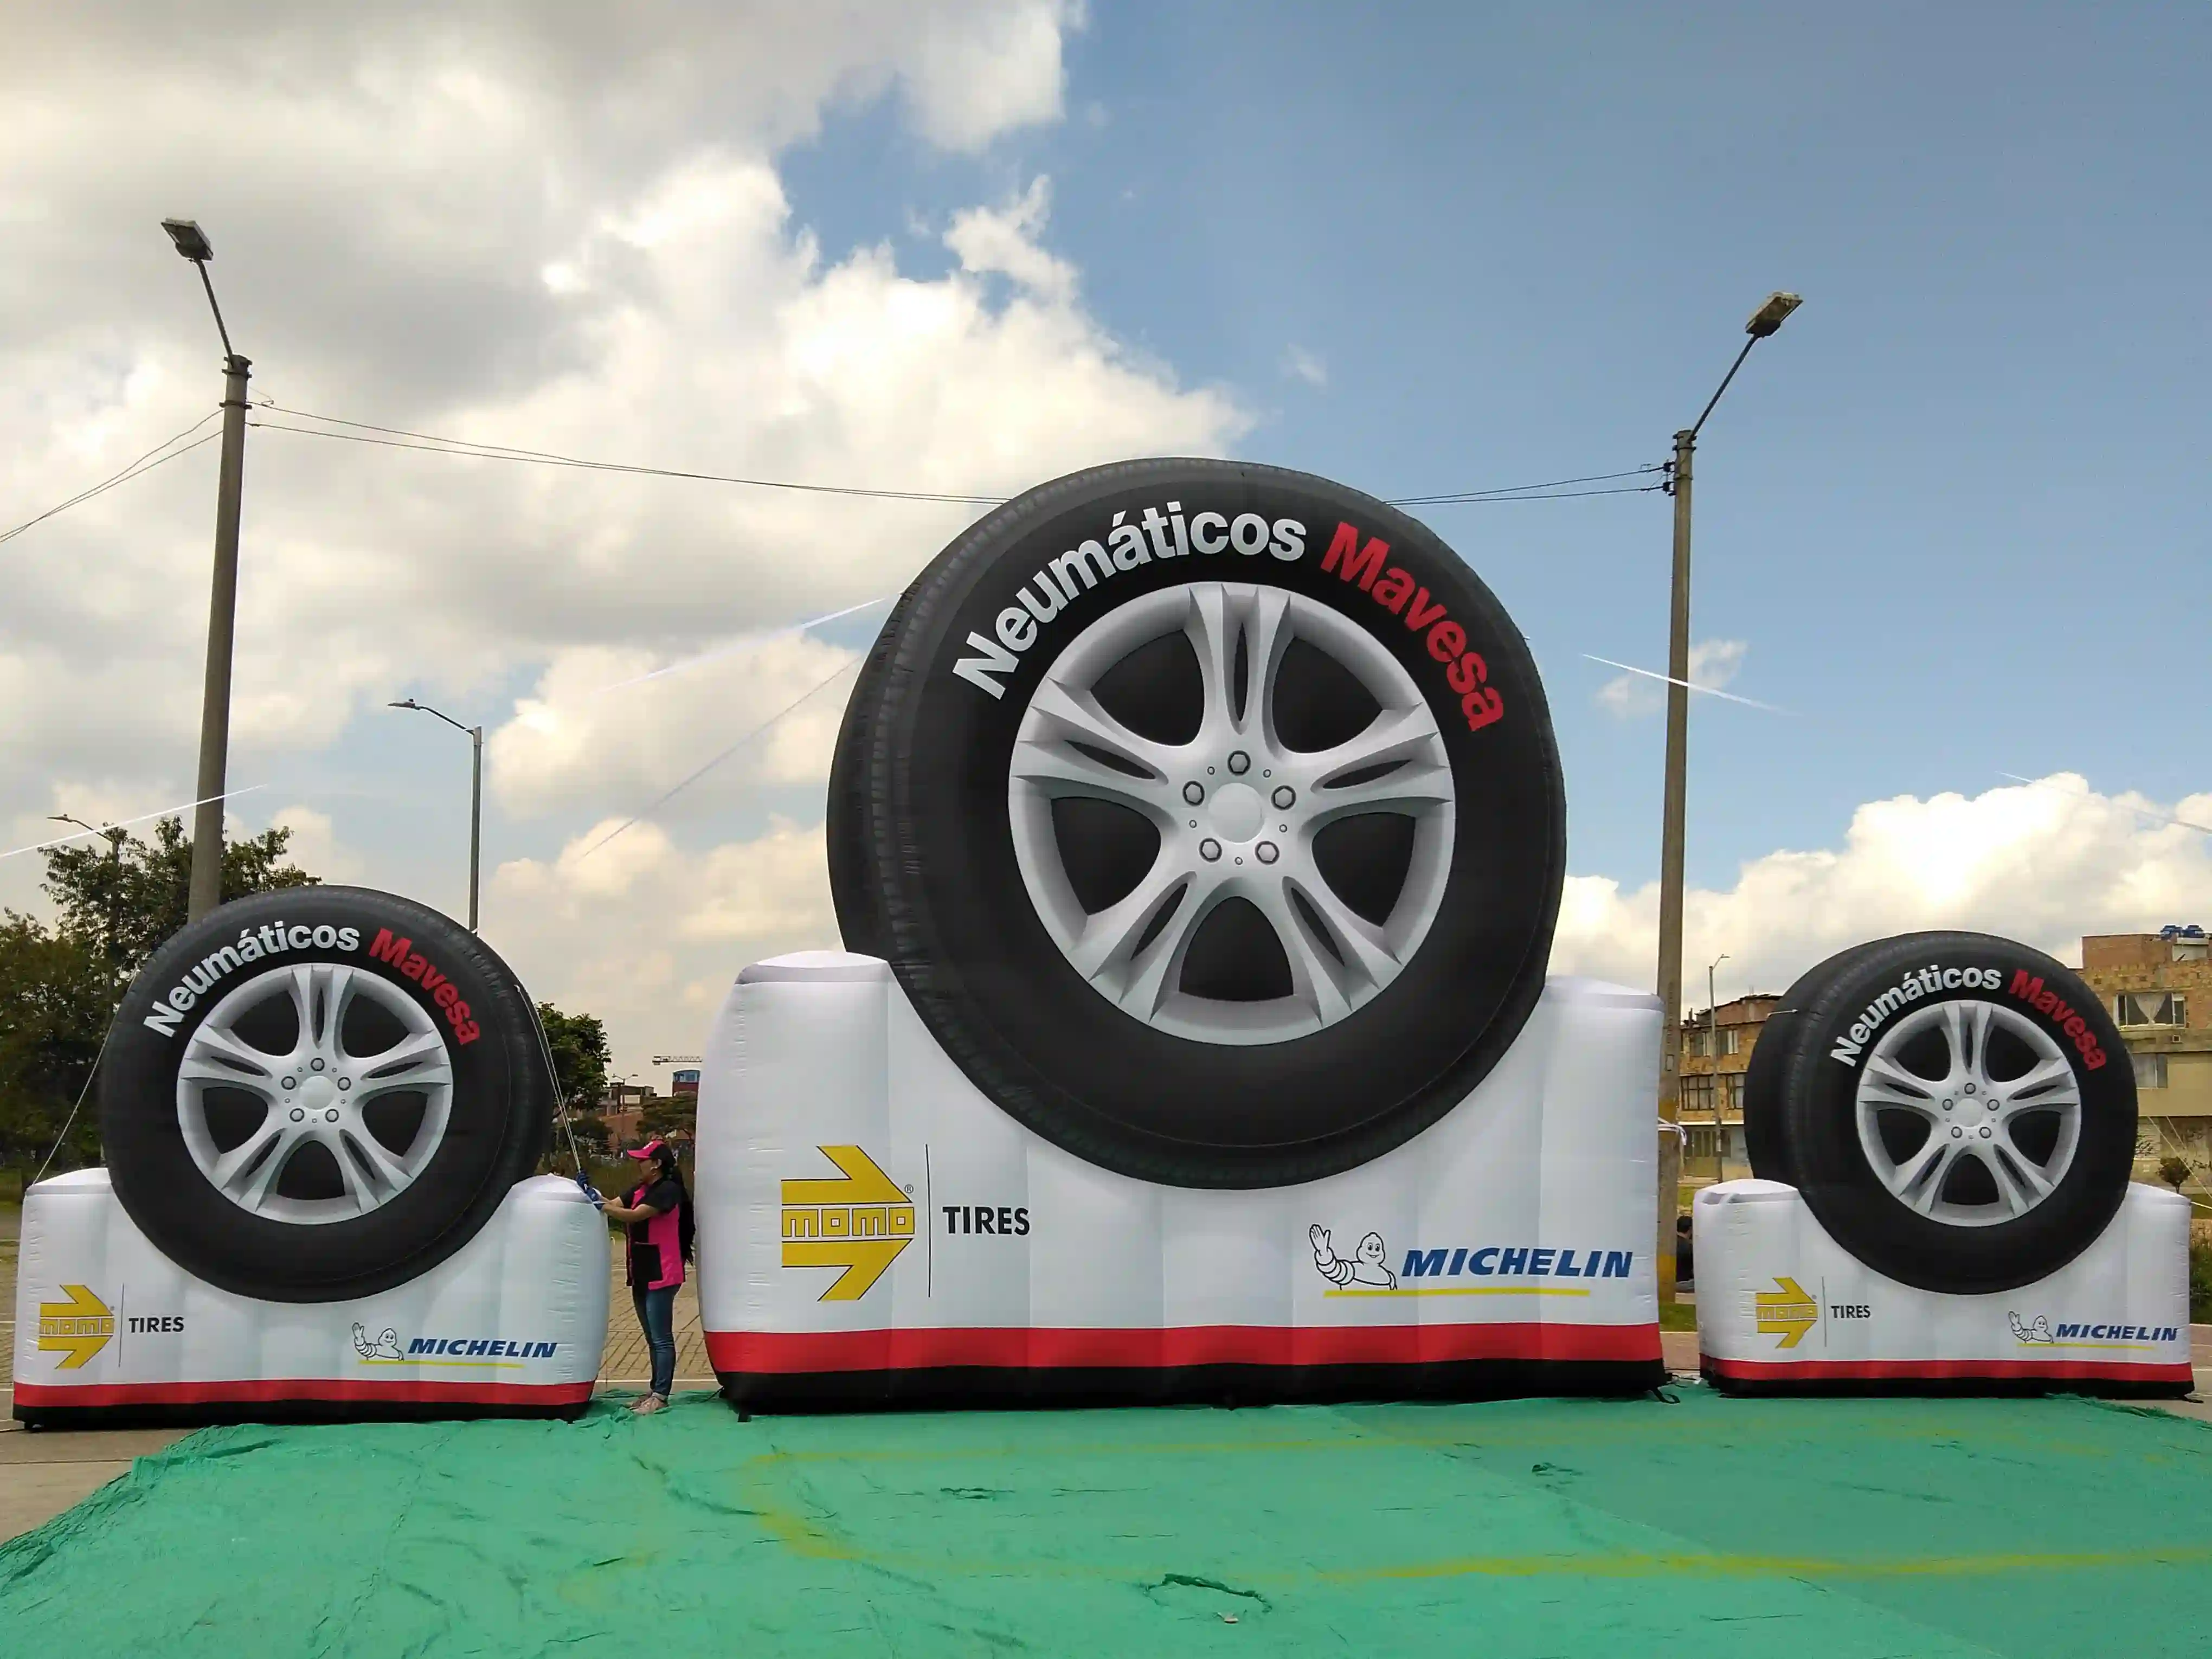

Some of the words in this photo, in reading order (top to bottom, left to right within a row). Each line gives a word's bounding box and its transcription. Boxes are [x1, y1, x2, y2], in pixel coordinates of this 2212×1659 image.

[953, 501, 1306, 699] Neumáticos
[1321, 522, 1503, 730] Mavesa
[144, 921, 359, 1037] Neumáticos
[370, 928, 479, 1044] Mavesa
[1831, 965, 2001, 1066] Neumáticos
[2010, 969, 2106, 1070] Mavesa
[942, 1206, 1030, 1236] TIRES
[1401, 1247, 1632, 1278] MICHELIN
[128, 1316, 184, 1333] TIRES
[1830, 1305, 1870, 1319] TIRES
[2055, 1323, 2177, 1341] MICHELIN
[408, 1338, 557, 1358] MICHELIN
